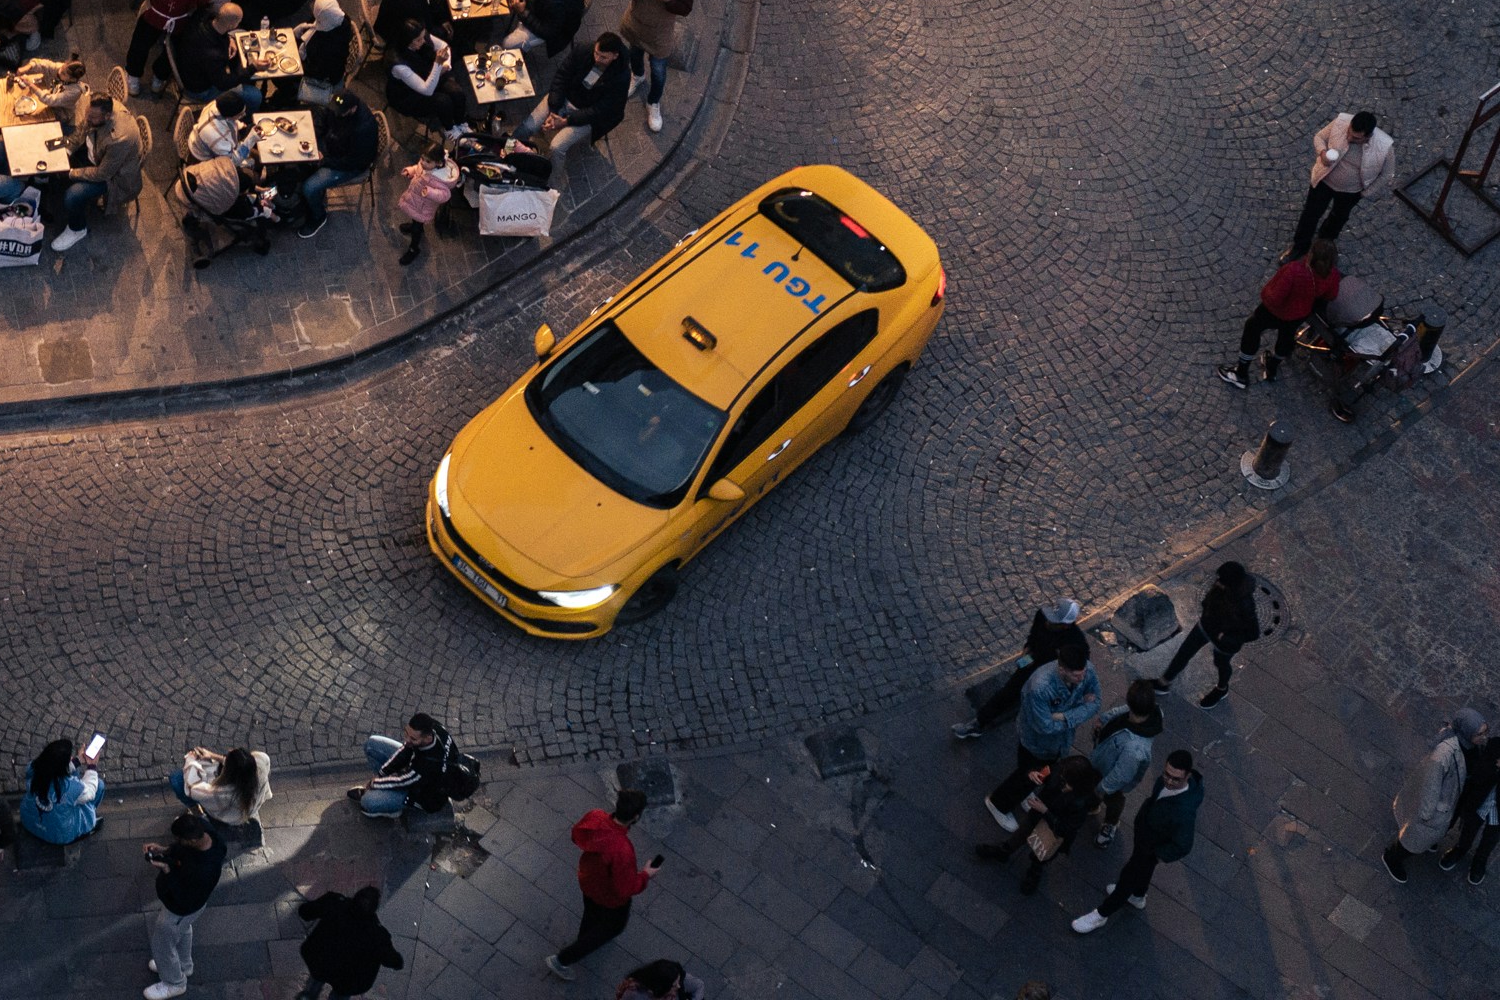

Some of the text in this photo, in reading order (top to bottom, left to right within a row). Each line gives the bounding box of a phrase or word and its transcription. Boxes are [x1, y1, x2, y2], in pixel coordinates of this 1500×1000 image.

[497, 212, 538, 222] MANGO
[724, 231, 827, 315] TGU 11
